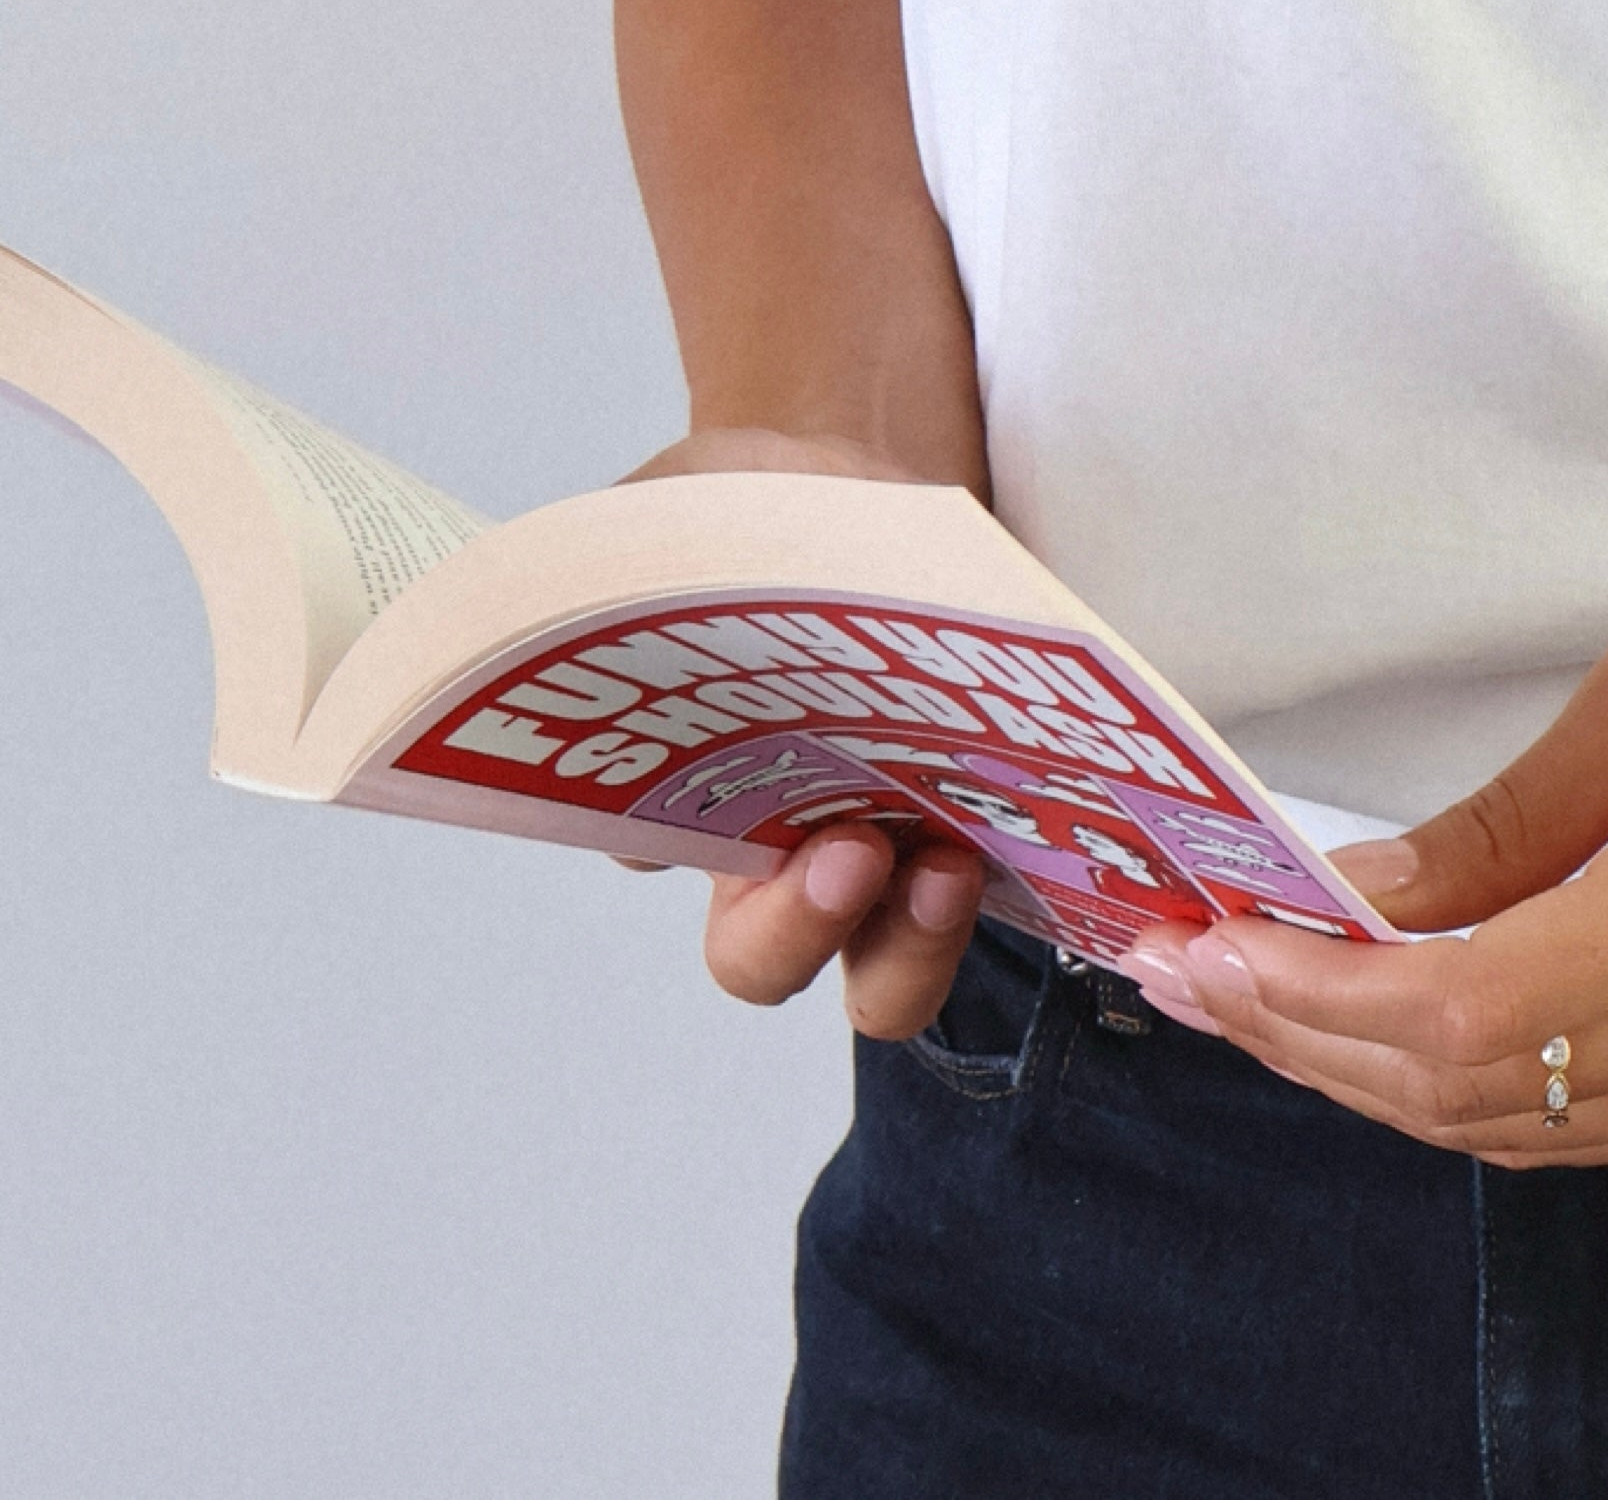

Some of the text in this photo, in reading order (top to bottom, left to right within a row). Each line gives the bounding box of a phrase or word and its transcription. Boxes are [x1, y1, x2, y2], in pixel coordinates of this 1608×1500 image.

[442, 612, 1137, 766] FUNNY YOU
[554, 671, 1217, 800] SHOULD ASK
